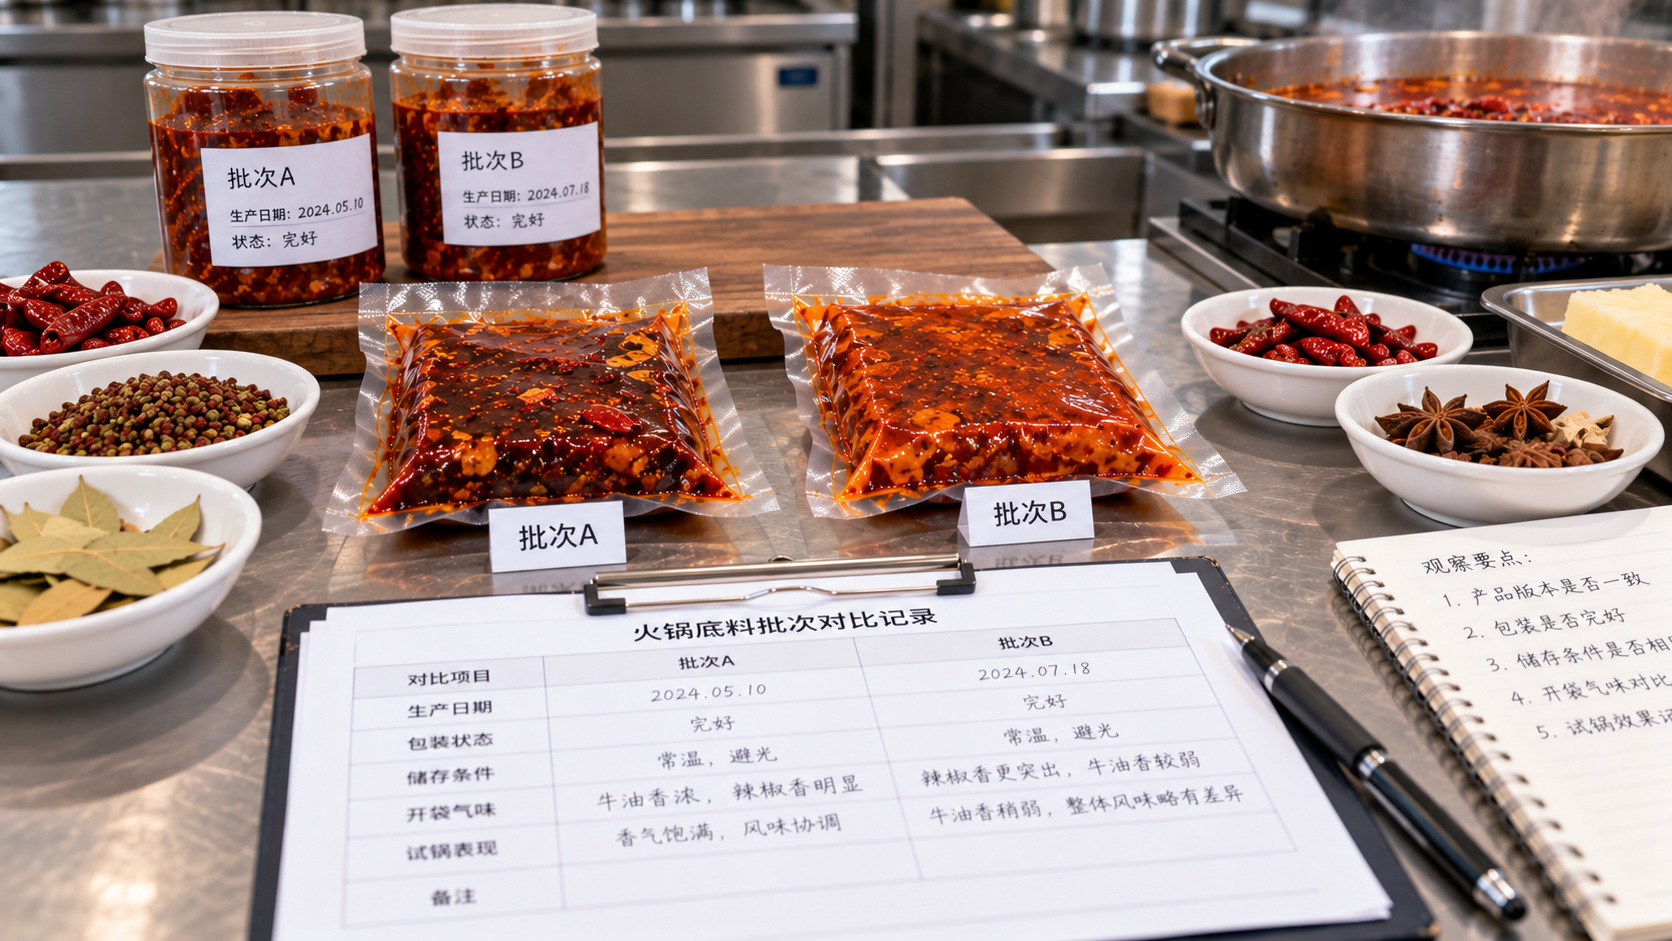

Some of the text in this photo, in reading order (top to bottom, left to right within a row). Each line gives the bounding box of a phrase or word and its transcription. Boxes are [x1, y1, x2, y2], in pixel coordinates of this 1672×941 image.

[461, 150, 525, 172] 批次B
[227, 166, 296, 190] 批次A
[463, 212, 545, 230] 状态：完好
[231, 230, 318, 250] 状态：完好
[993, 499, 1067, 528] 批次B
[518, 522, 599, 552] 批次A
[1420, 549, 1532, 575] 观察要点：
[1443, 571, 1651, 608] 1. 产品版本是否一致
[633, 607, 938, 642] 火锅底料批次对比记录
[1463, 607, 1625, 640] 2. 包装是否完好
[997, 635, 1054, 651] 批次B
[678, 654, 736, 671] 批次A
[1486, 635, 1672, 672] 3. 储存条件是否相
[407, 669, 490, 687] 对比项目
[978, 662, 1091, 681] 2024.07.18
[651, 684, 767, 703] 2024.05.10
[1511, 673, 1672, 705] 4. 开袋气味对比
[407, 700, 493, 719] 生产日期
[1023, 693, 1067, 711] 完好
[690, 715, 736, 733] 完好
[1003, 722, 1120, 746] 常温，避光
[1536, 725, 1557, 740] 5.
[407, 732, 494, 751] 包装状态
[657, 746, 778, 770] 常温，避光
[406, 766, 494, 786] 储存条件
[407, 802, 496, 823] 开袋气味
[407, 840, 498, 861] 试锅表现
[431, 888, 474, 907] 备注
